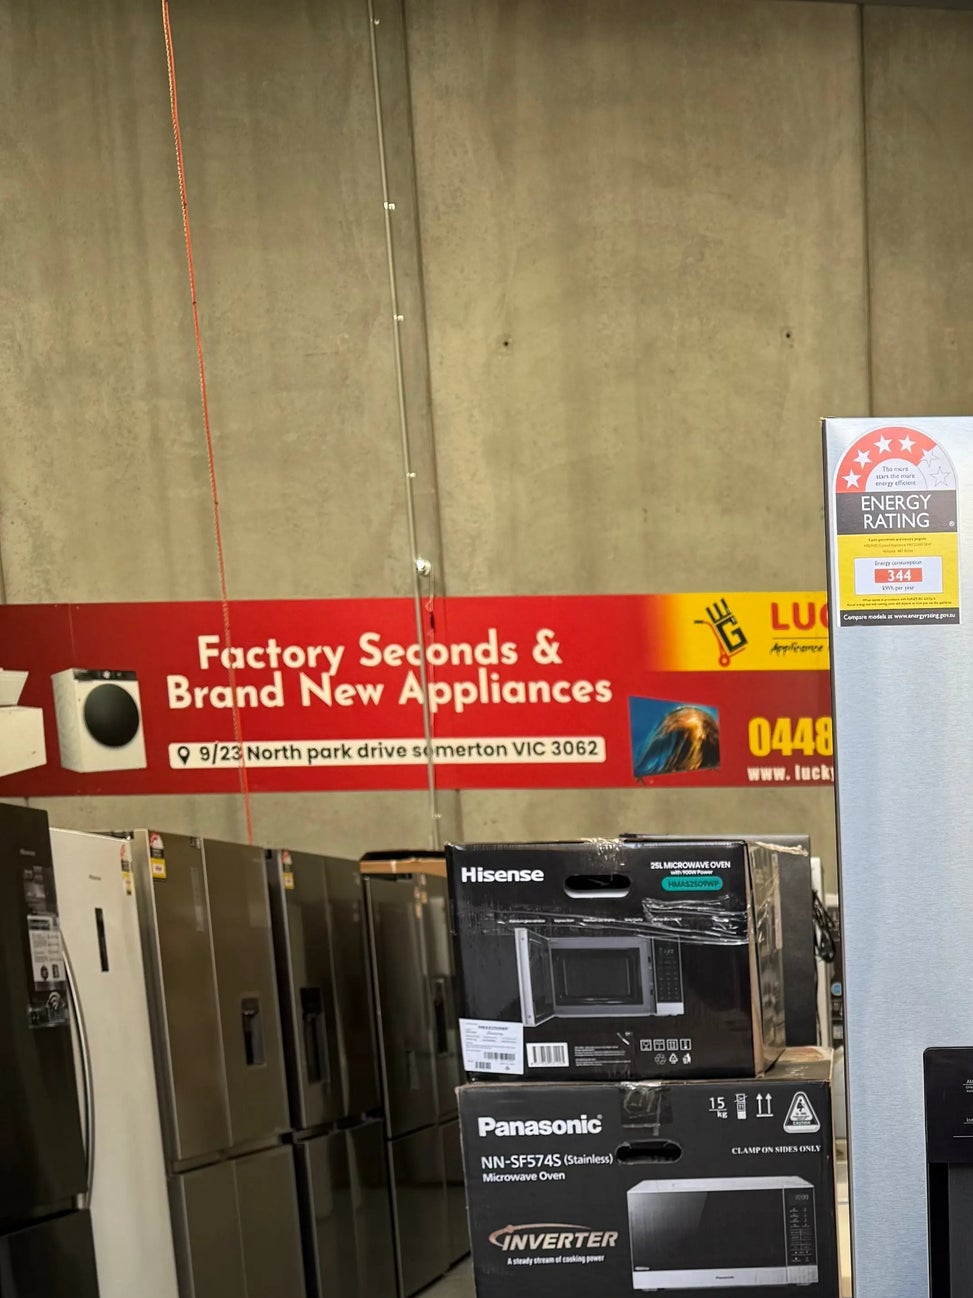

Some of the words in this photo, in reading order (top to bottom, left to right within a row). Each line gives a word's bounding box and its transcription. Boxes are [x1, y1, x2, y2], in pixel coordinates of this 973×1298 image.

[861, 494, 931, 511] ENERGY
[864, 513, 930, 529] RATING
[888, 569, 912, 582] 344
[198, 634, 345, 677] Factory
[359, 627, 519, 668] Seconds
[532, 628, 563, 665] &
[166, 671, 285, 709] Brand
[300, 671, 384, 707] New
[398, 667, 613, 714] Appliances
[748, 717, 834, 757] 0448
[200, 745, 242, 765] 9/23
[247, 744, 302, 761] North
[308, 743, 352, 764] park
[357, 741, 408, 759] drive
[413, 742, 508, 758] somerton
[512, 741, 546, 757] VIC
[551, 740, 599, 756] 3062
[650, 861, 663, 869] 25L
[664, 861, 709, 869] MICROWAVE
[710, 861, 731, 869] OVEN
[461, 867, 544, 882] Hisense
[709, 1096, 725, 1109] 15
[717, 1111, 728, 1119] kg
[478, 1114, 602, 1137] Panasonic
[732, 1147, 760, 1155] CLAMP
[775, 1145, 798, 1153] SIDES
[799, 1144, 821, 1152] ONLY
[481, 1153, 561, 1169] NN-SF574S
[563, 1153, 613, 1166] (Stainless)
[482, 1172, 537, 1182] Microwave
[539, 1171, 566, 1180] Oven
[502, 1231, 619, 1251] INVERTER
[513, 1257, 533, 1266] steady
[534, 1256, 554, 1264] stream
[556, 1255, 562, 1263] of
[563, 1255, 585, 1264] cooking
[587, 1255, 605, 1263] power
